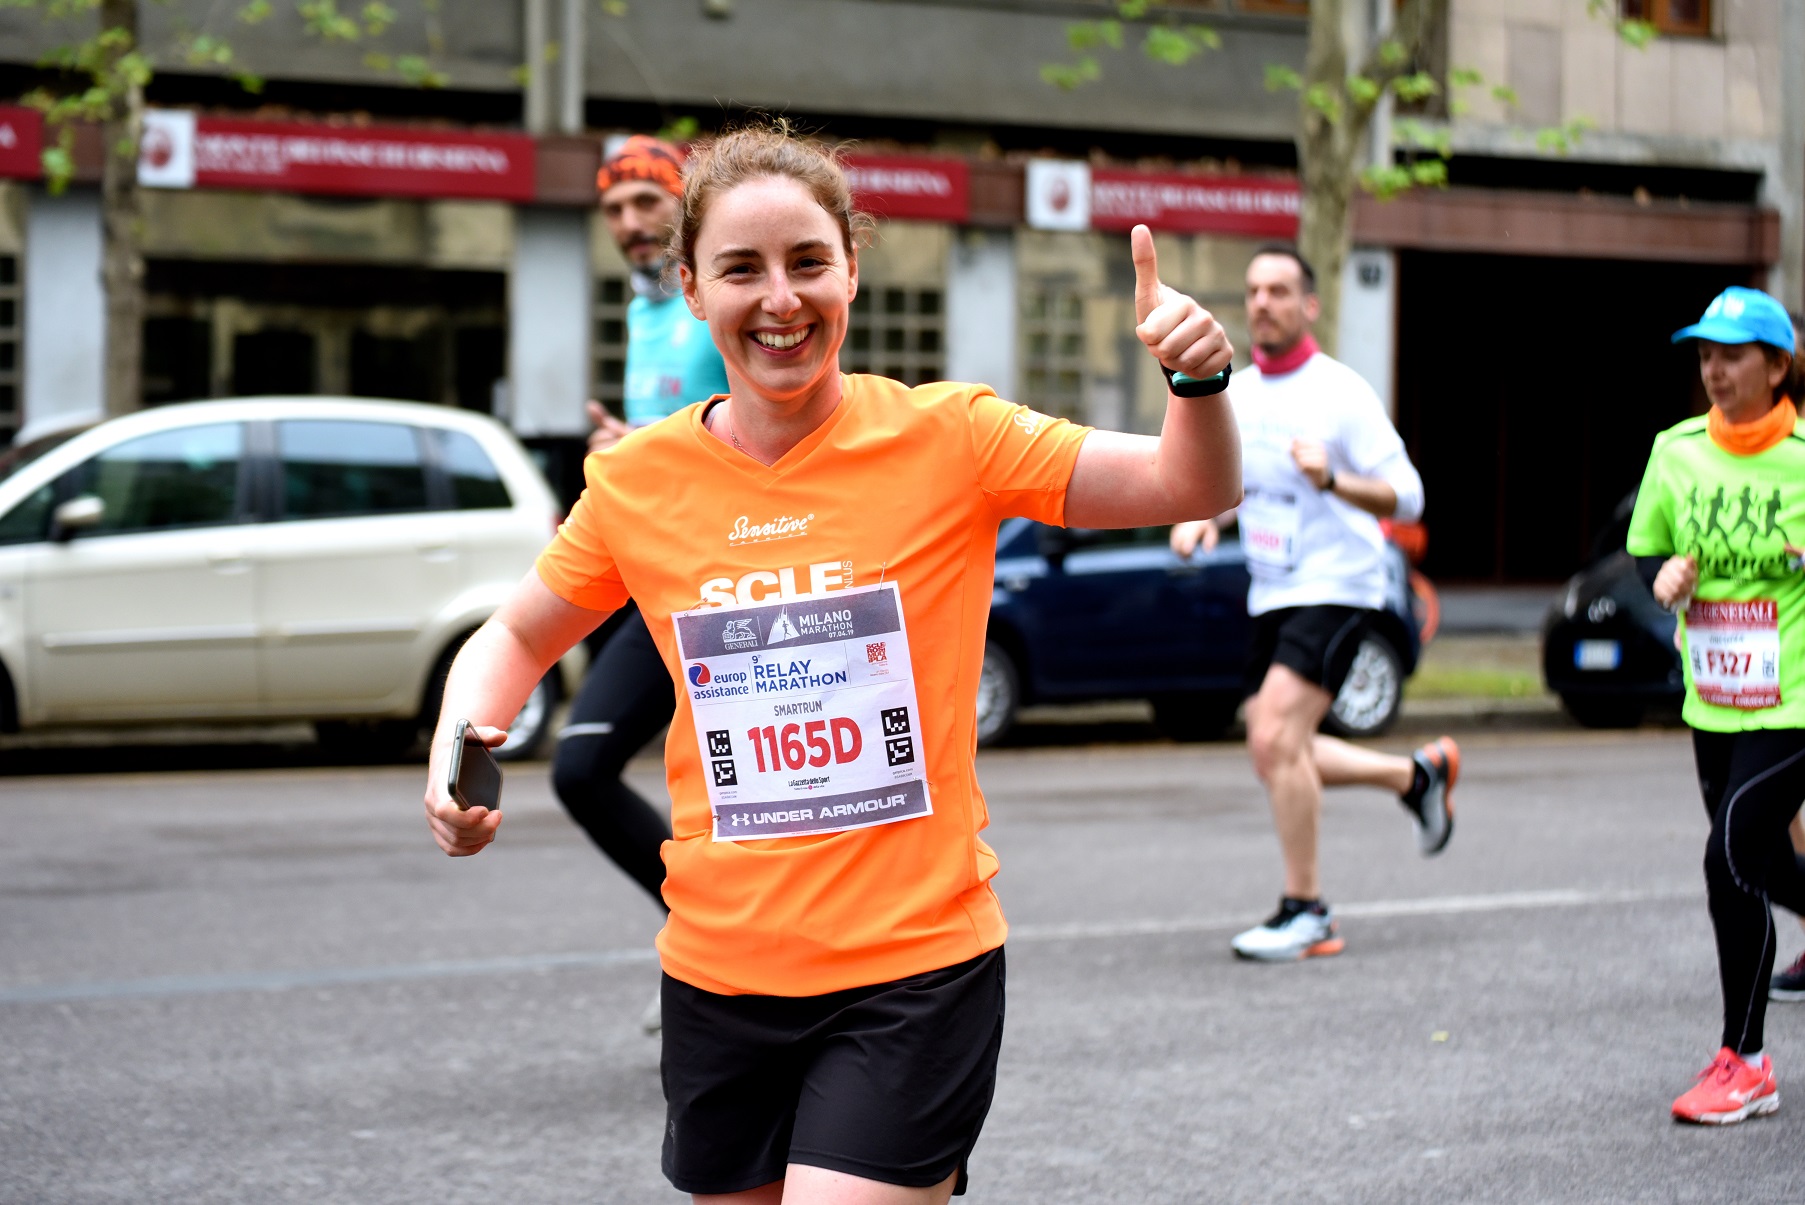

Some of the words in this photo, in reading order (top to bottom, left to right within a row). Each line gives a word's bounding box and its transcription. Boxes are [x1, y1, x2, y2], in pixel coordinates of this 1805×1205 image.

[842, 560, 854, 589] NLUS
[799, 609, 852, 628] MILANO
[800, 621, 853, 636] MARATHON
[828, 629, 854, 639] 07.04.19
[724, 640, 759, 651] GENERALI
[713, 671, 747, 685] europ
[753, 659, 812, 680] RELAY
[755, 670, 847, 694] MARATHON
[694, 685, 749, 700] assistance
[773, 700, 823, 717] SMARTRUN
[747, 717, 863, 773] 1165D
[752, 809, 814, 825] UNDER
[819, 794, 906, 819] ARMOUR
